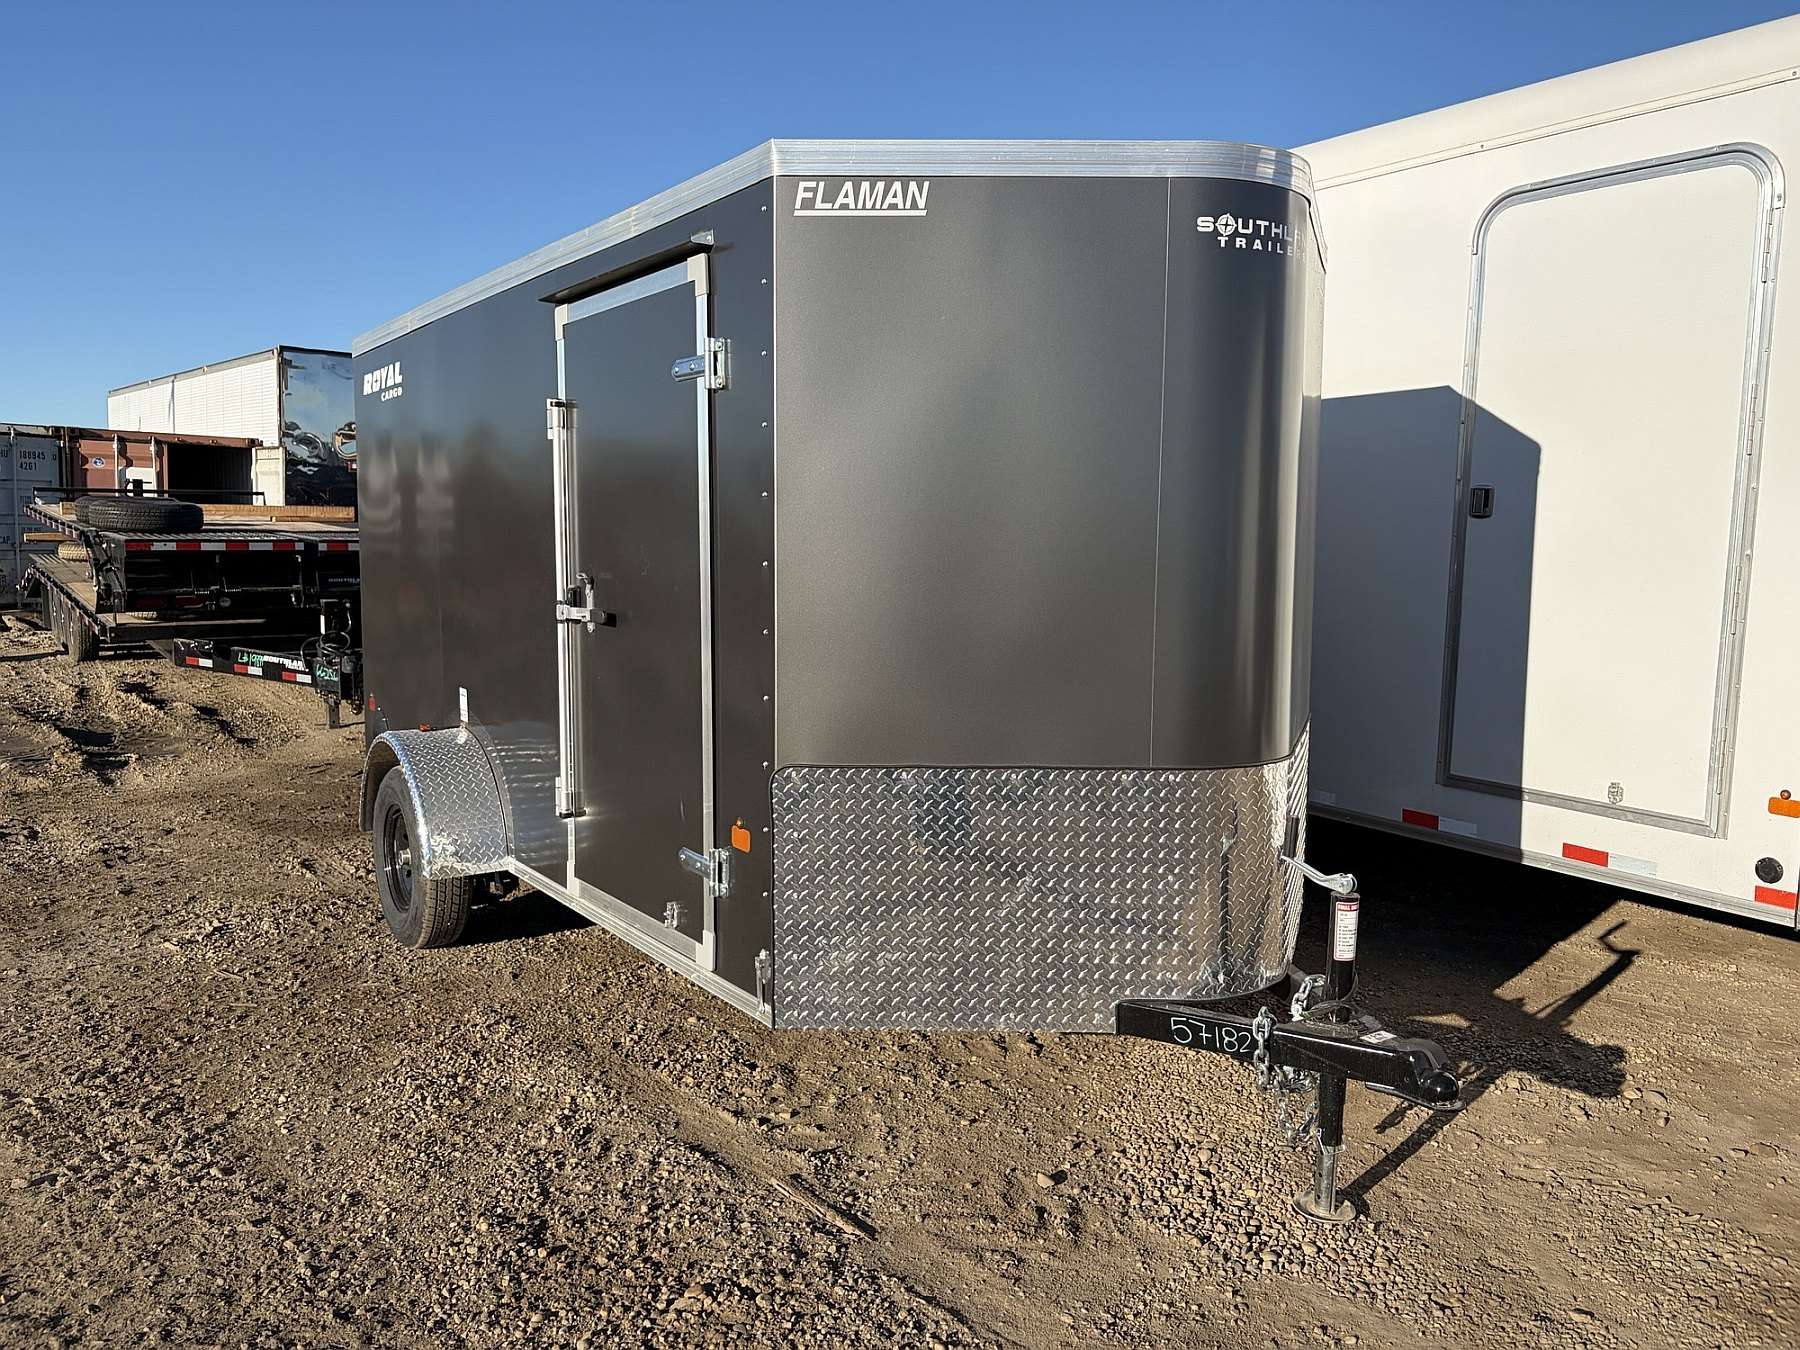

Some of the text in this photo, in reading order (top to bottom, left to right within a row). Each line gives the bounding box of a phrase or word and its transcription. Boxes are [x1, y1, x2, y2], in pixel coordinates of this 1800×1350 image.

[795, 181, 930, 209] FLAMAN
[1196, 213, 1297, 242] SOUTHL
[1217, 236, 1293, 256] TRAILE
[363, 361, 403, 395] ROYAL
[381, 386, 403, 402] CARGO
[1171, 1017, 1254, 1052] 57182
